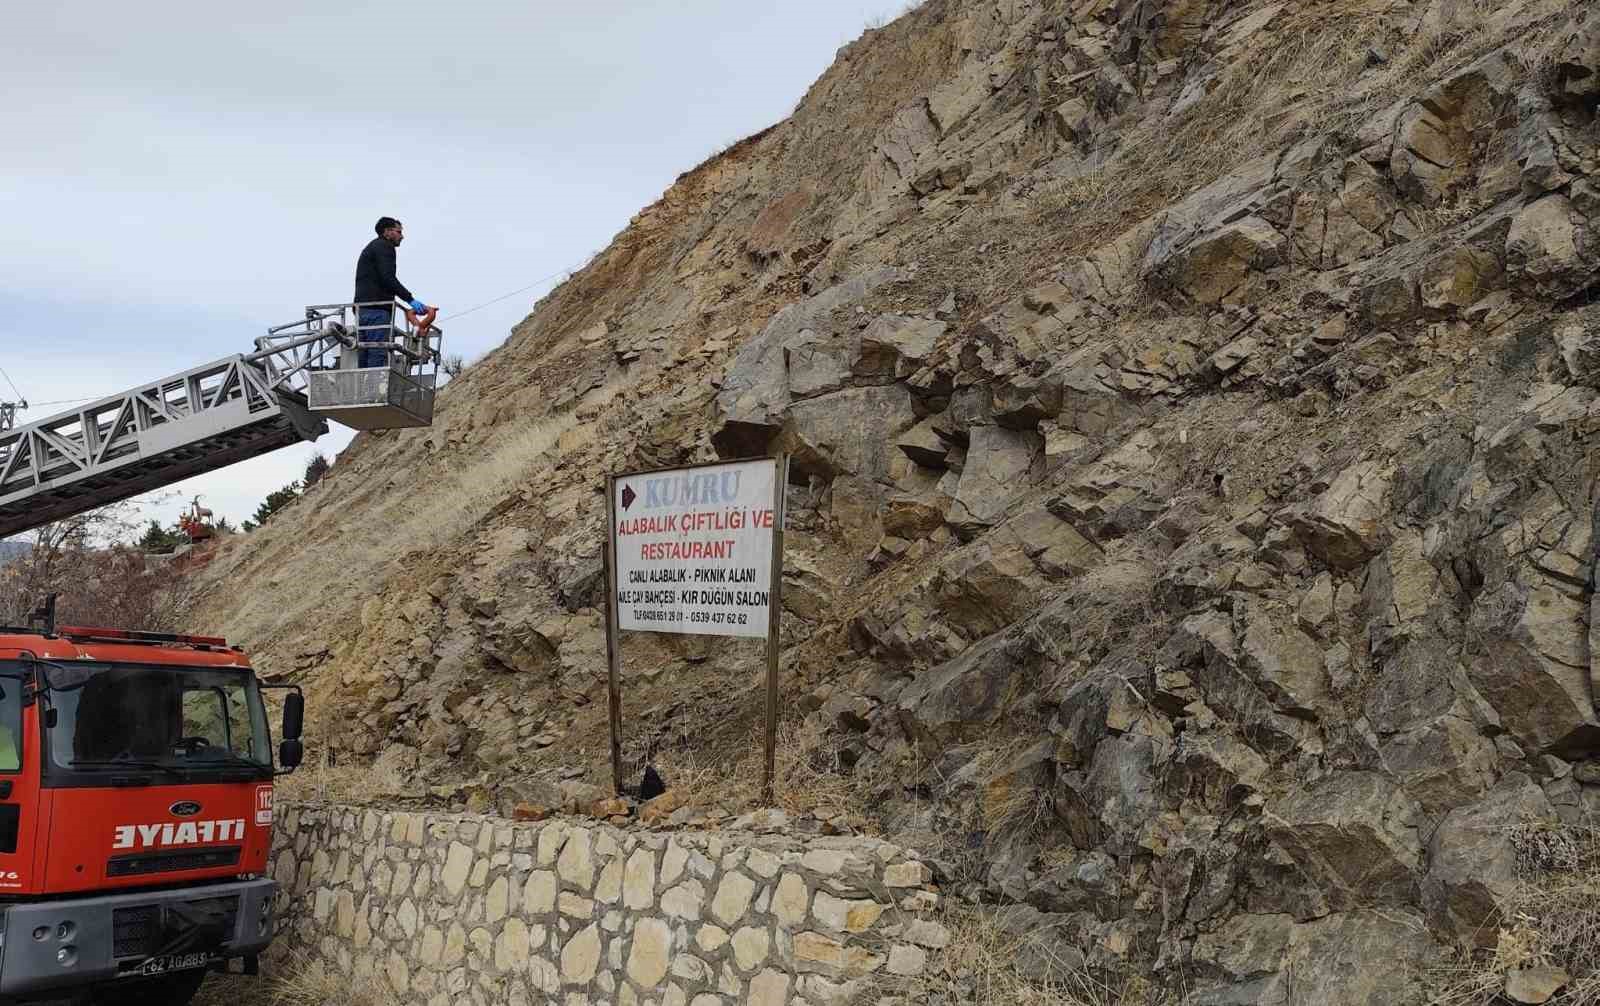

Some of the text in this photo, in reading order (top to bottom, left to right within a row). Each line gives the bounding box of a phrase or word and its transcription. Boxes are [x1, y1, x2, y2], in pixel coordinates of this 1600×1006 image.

[644, 470, 742, 508] KUMRU
[618, 505, 774, 537] ALABALIK ÇİFTLİĞİ VE
[641, 540, 735, 560] RESTAURANT
[629, 570, 648, 584] CANLI
[650, 568, 686, 583] ALABALIK
[694, 565, 726, 583] PİKNİK
[728, 568, 756, 583] ALANI
[681, 590, 699, 604] KIR
[727, 613, 737, 625] 62
